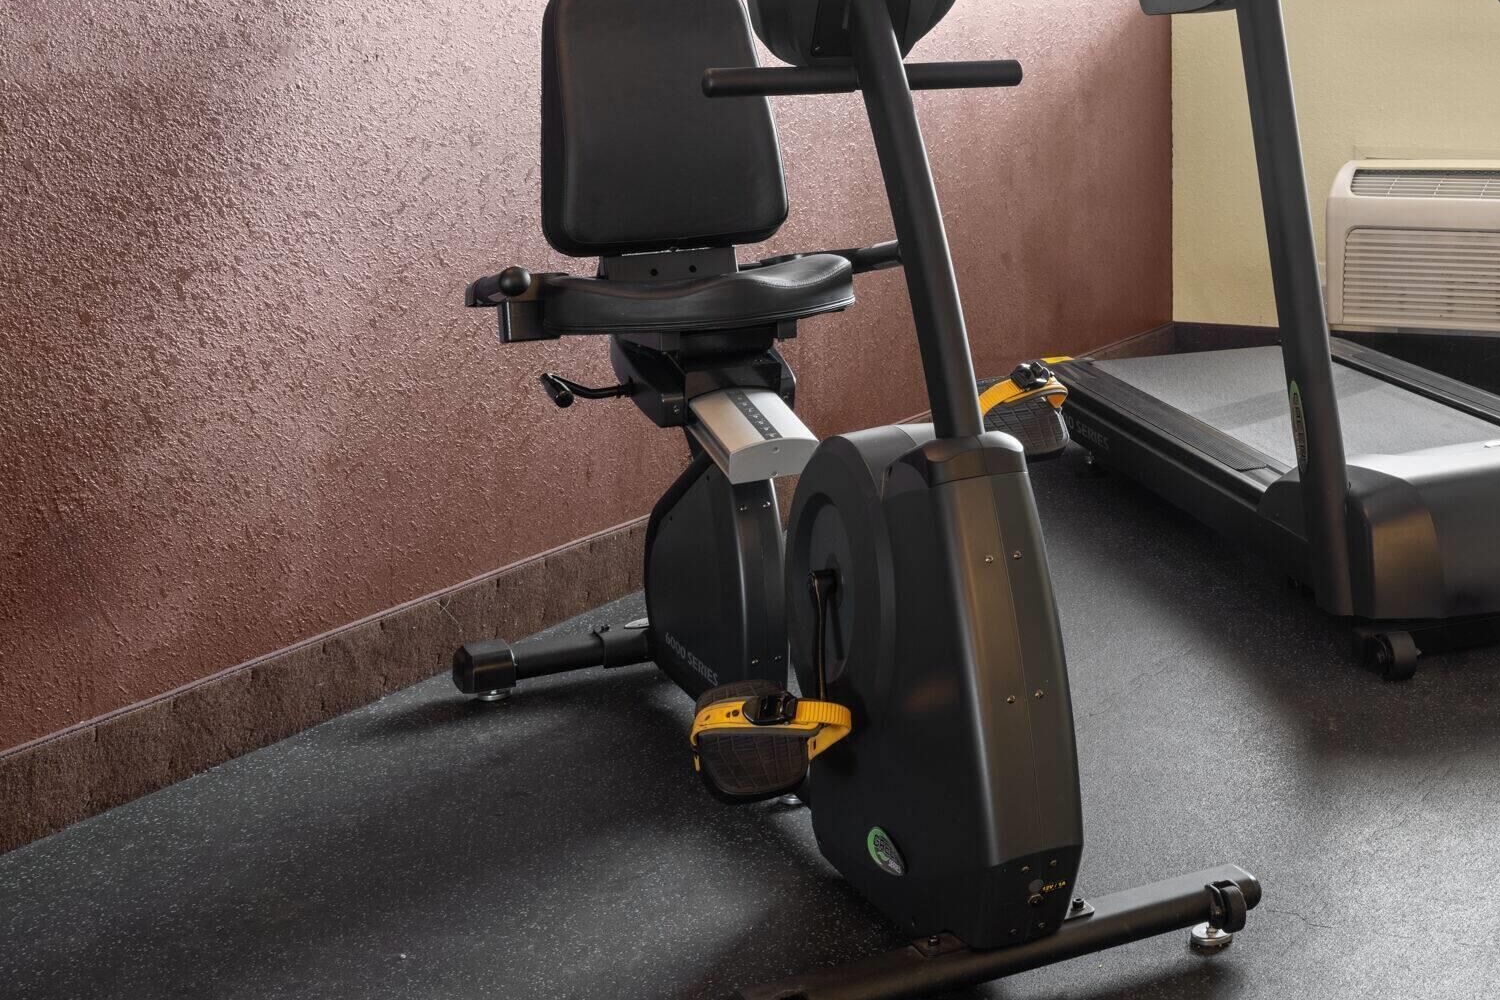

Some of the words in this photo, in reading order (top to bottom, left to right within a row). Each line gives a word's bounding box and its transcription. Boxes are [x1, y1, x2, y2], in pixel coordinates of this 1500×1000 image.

[1075, 419, 1111, 450] SERIES
[665, 631, 686, 660] 6000
[687, 651, 719, 687] SERIES
